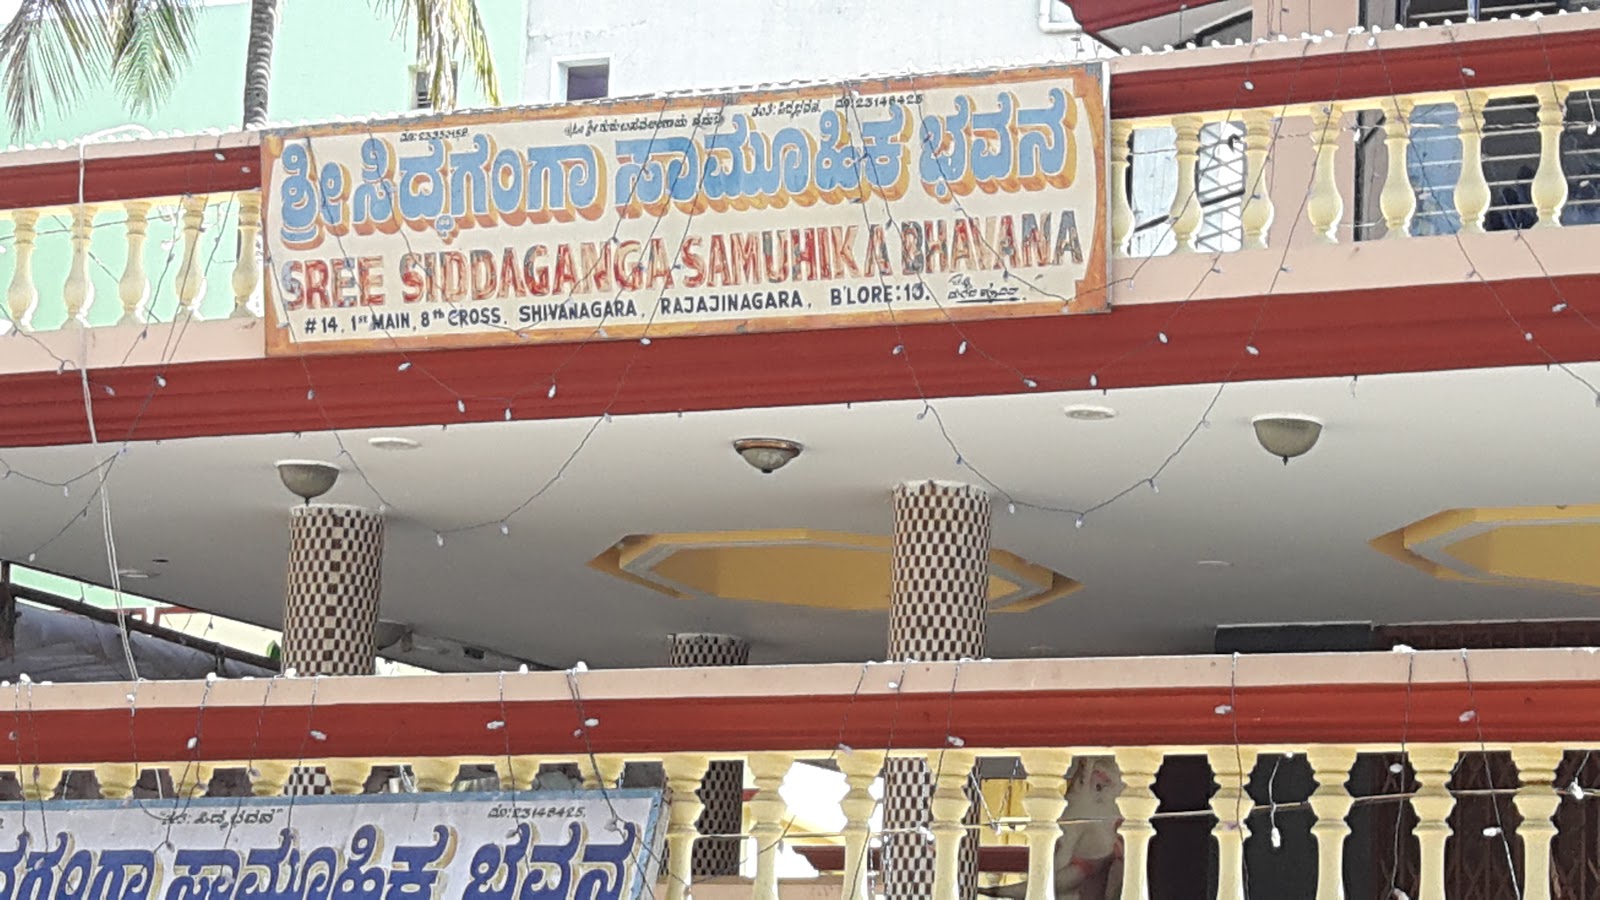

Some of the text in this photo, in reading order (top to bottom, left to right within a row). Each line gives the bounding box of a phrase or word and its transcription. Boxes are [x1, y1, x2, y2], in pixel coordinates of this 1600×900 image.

[280, 142, 345, 244] ಶ್ರೀ
[918, 86, 1072, 199] ಭವನ
[281, 255, 386, 312] SREE
[399, 237, 675, 304] SIDDAGANGA
[901, 209, 1084, 276] BHAVANA
